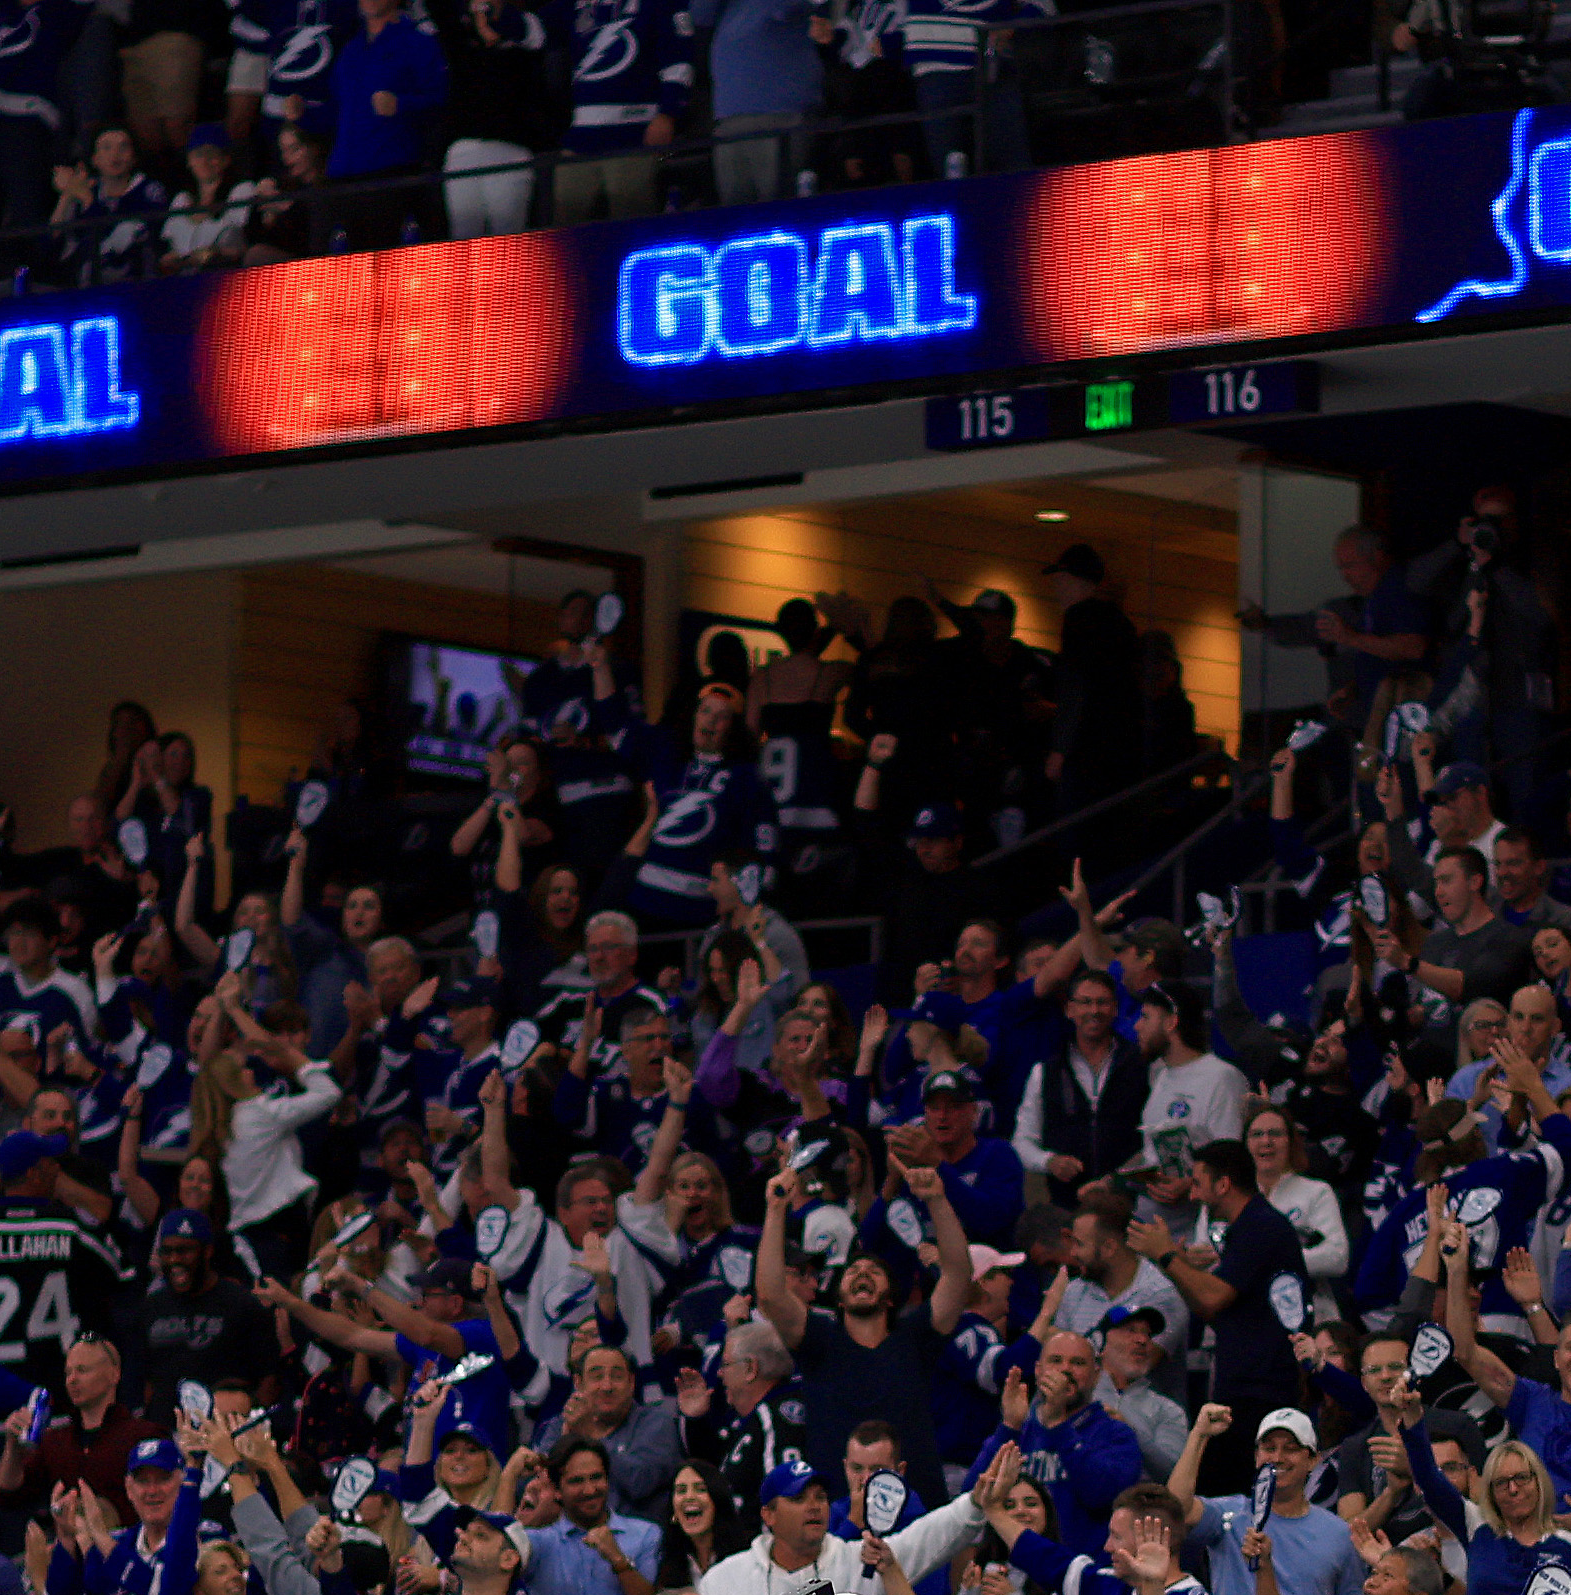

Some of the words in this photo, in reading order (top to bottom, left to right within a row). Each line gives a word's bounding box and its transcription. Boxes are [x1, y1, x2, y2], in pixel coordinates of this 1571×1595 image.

[619, 215, 976, 367] GOAL
[1204, 367, 1261, 414] 116
[960, 393, 1014, 438] 115
